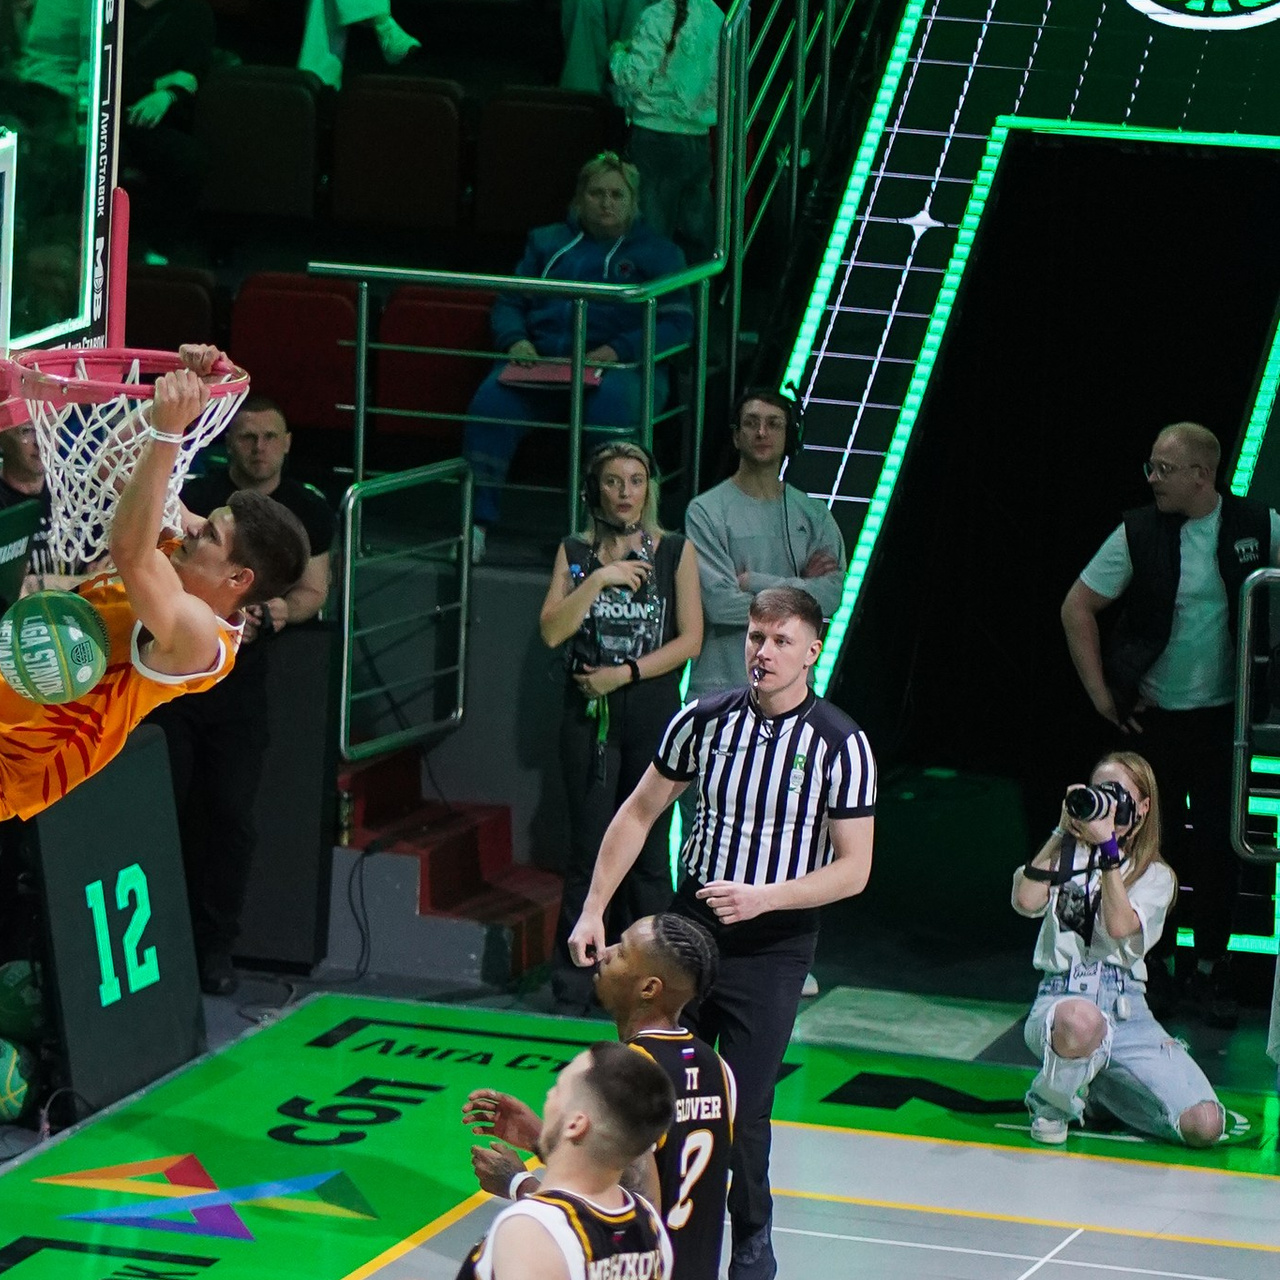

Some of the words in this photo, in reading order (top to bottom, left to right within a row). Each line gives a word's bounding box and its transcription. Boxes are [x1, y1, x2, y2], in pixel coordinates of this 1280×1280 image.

[21, 614, 51, 650] LIGA
[0, 660, 34, 700] BASKET
[23, 648, 64, 697] STAVOK
[85, 863, 160, 1007] 12
[349, 1037, 494, 1066] ЛИГА
[675, 1096, 721, 1123] GLOVER
[667, 1128, 714, 1230] 2
